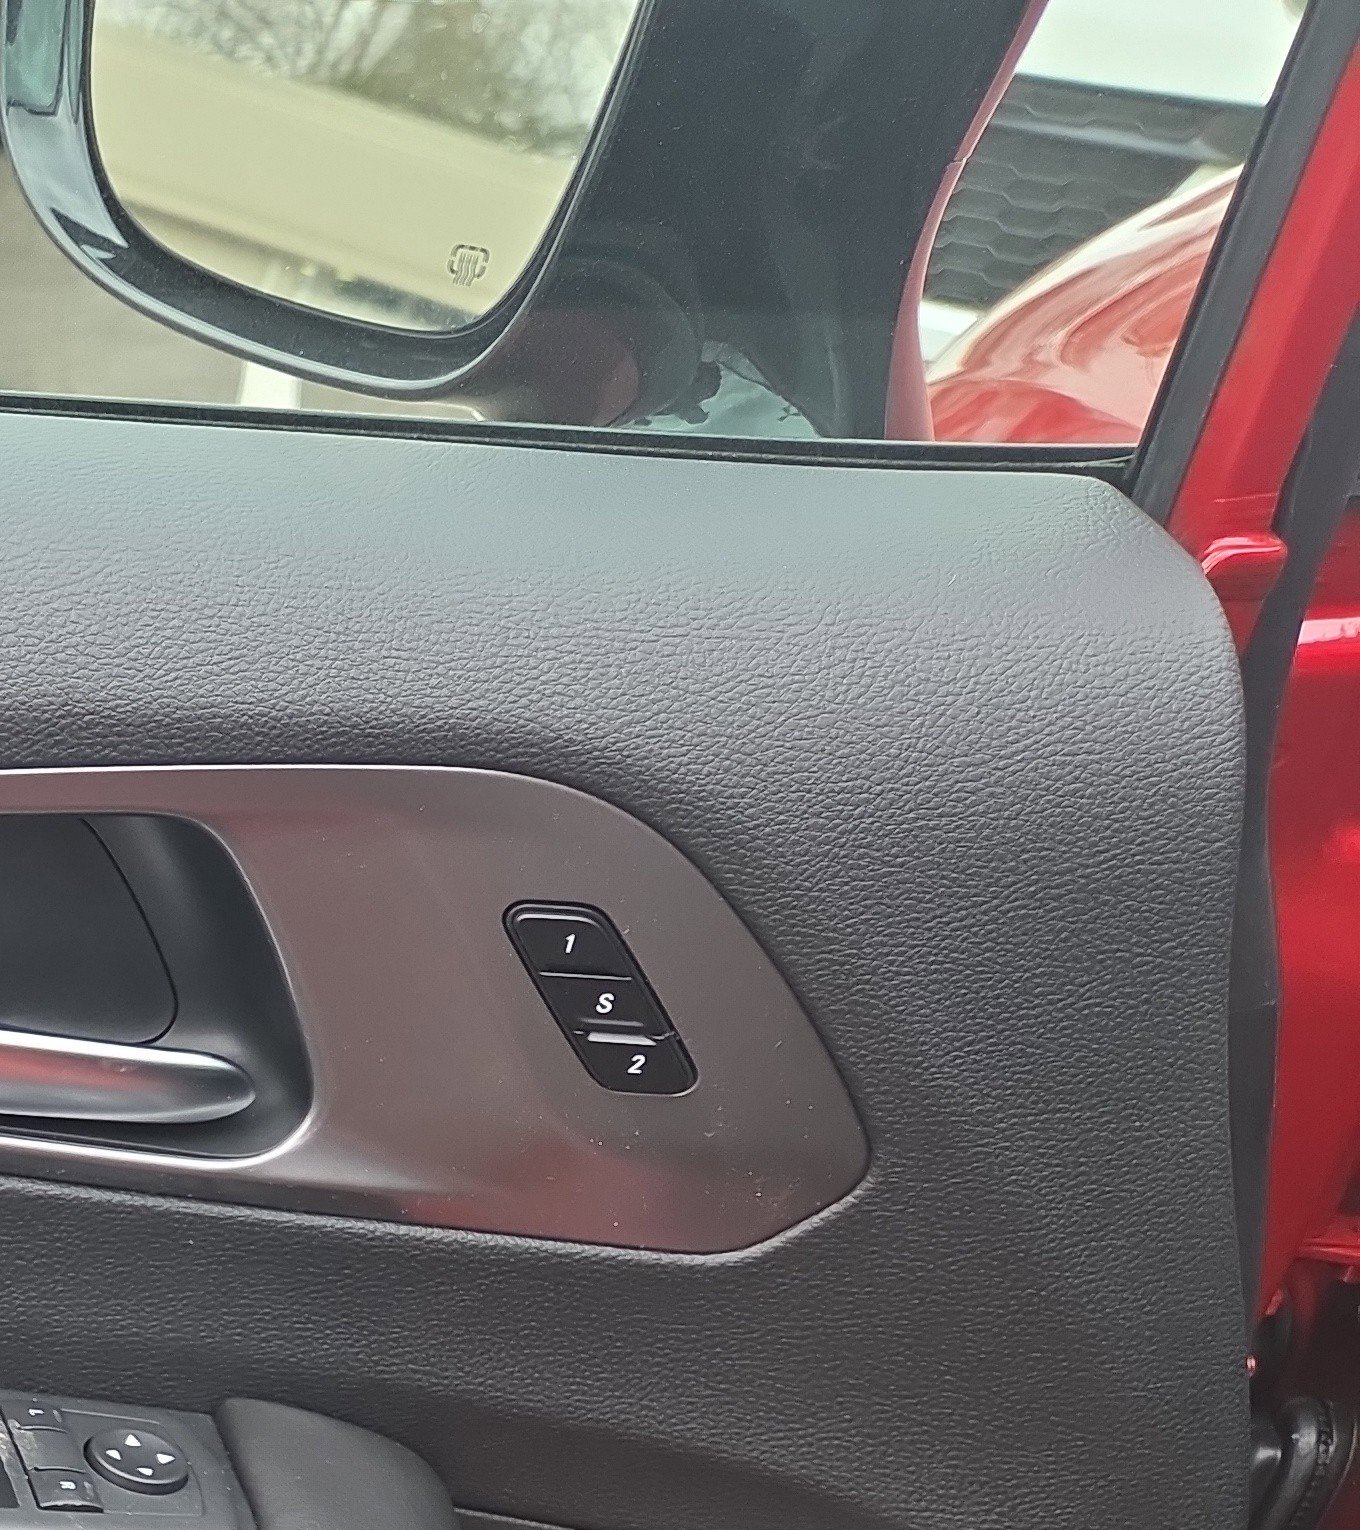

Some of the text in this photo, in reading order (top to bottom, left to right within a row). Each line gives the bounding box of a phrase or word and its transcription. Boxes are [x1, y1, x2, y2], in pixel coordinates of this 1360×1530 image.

[565, 933, 576, 954] 1
[595, 992, 615, 1014] S
[627, 1054, 646, 1075] 2
